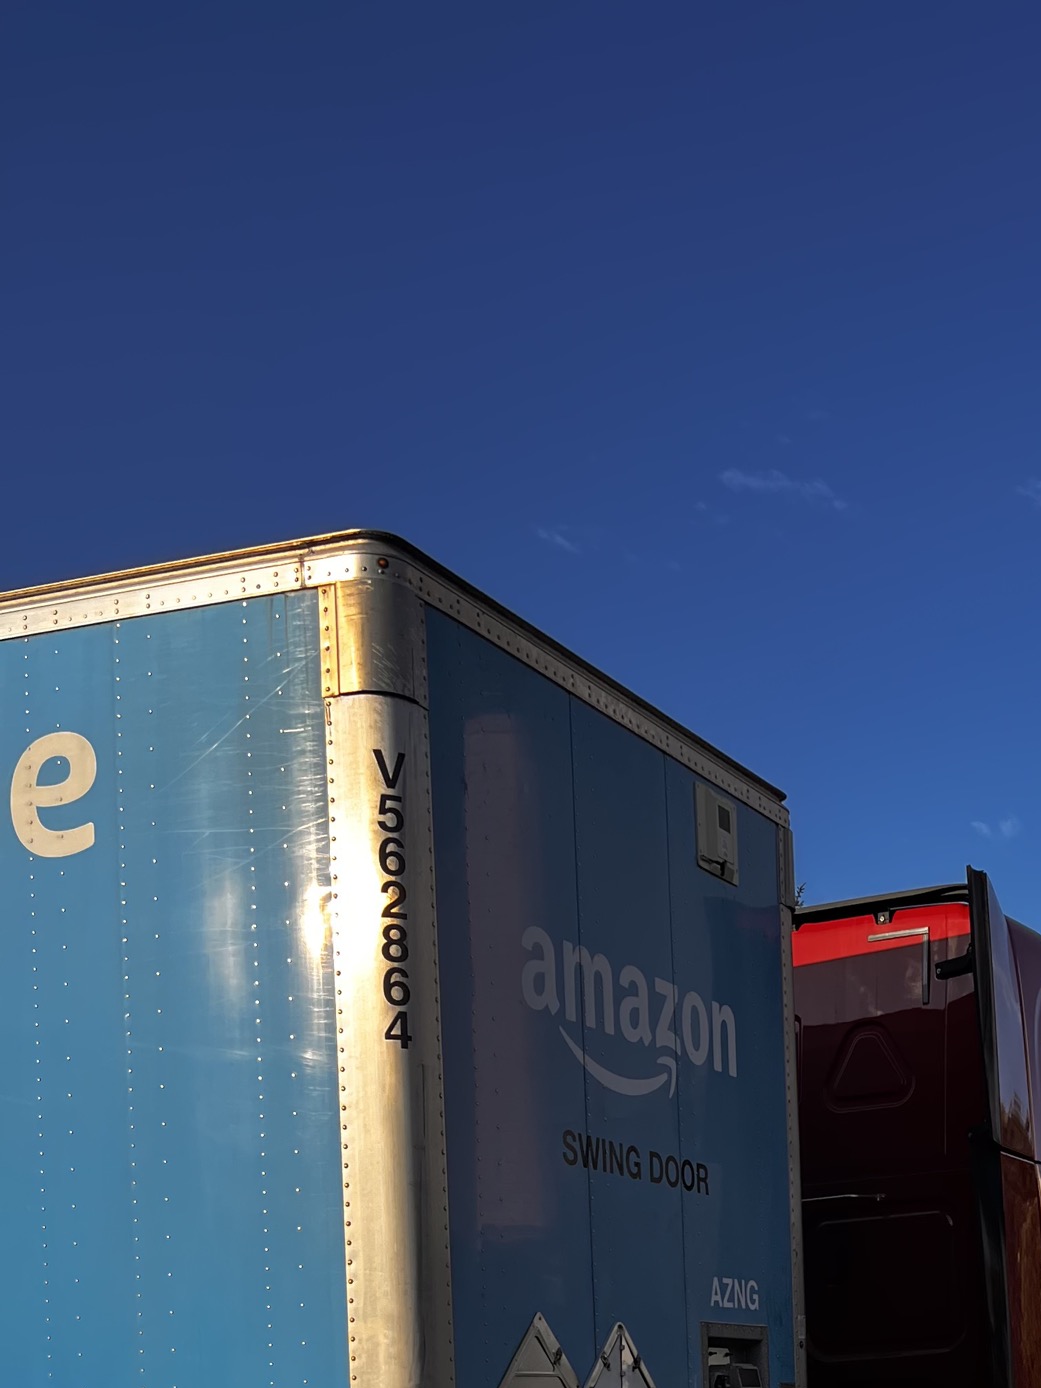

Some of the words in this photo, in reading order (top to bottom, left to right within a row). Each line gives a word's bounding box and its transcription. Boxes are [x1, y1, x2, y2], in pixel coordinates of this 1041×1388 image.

[10, 731, 97, 857] e
[373, 749, 412, 1049] V562864
[521, 926, 737, 1079] amazon
[562, 1129, 642, 1181] SWING
[650, 1151, 710, 1195] DOOR
[710, 1276, 760, 1311] AZNG
